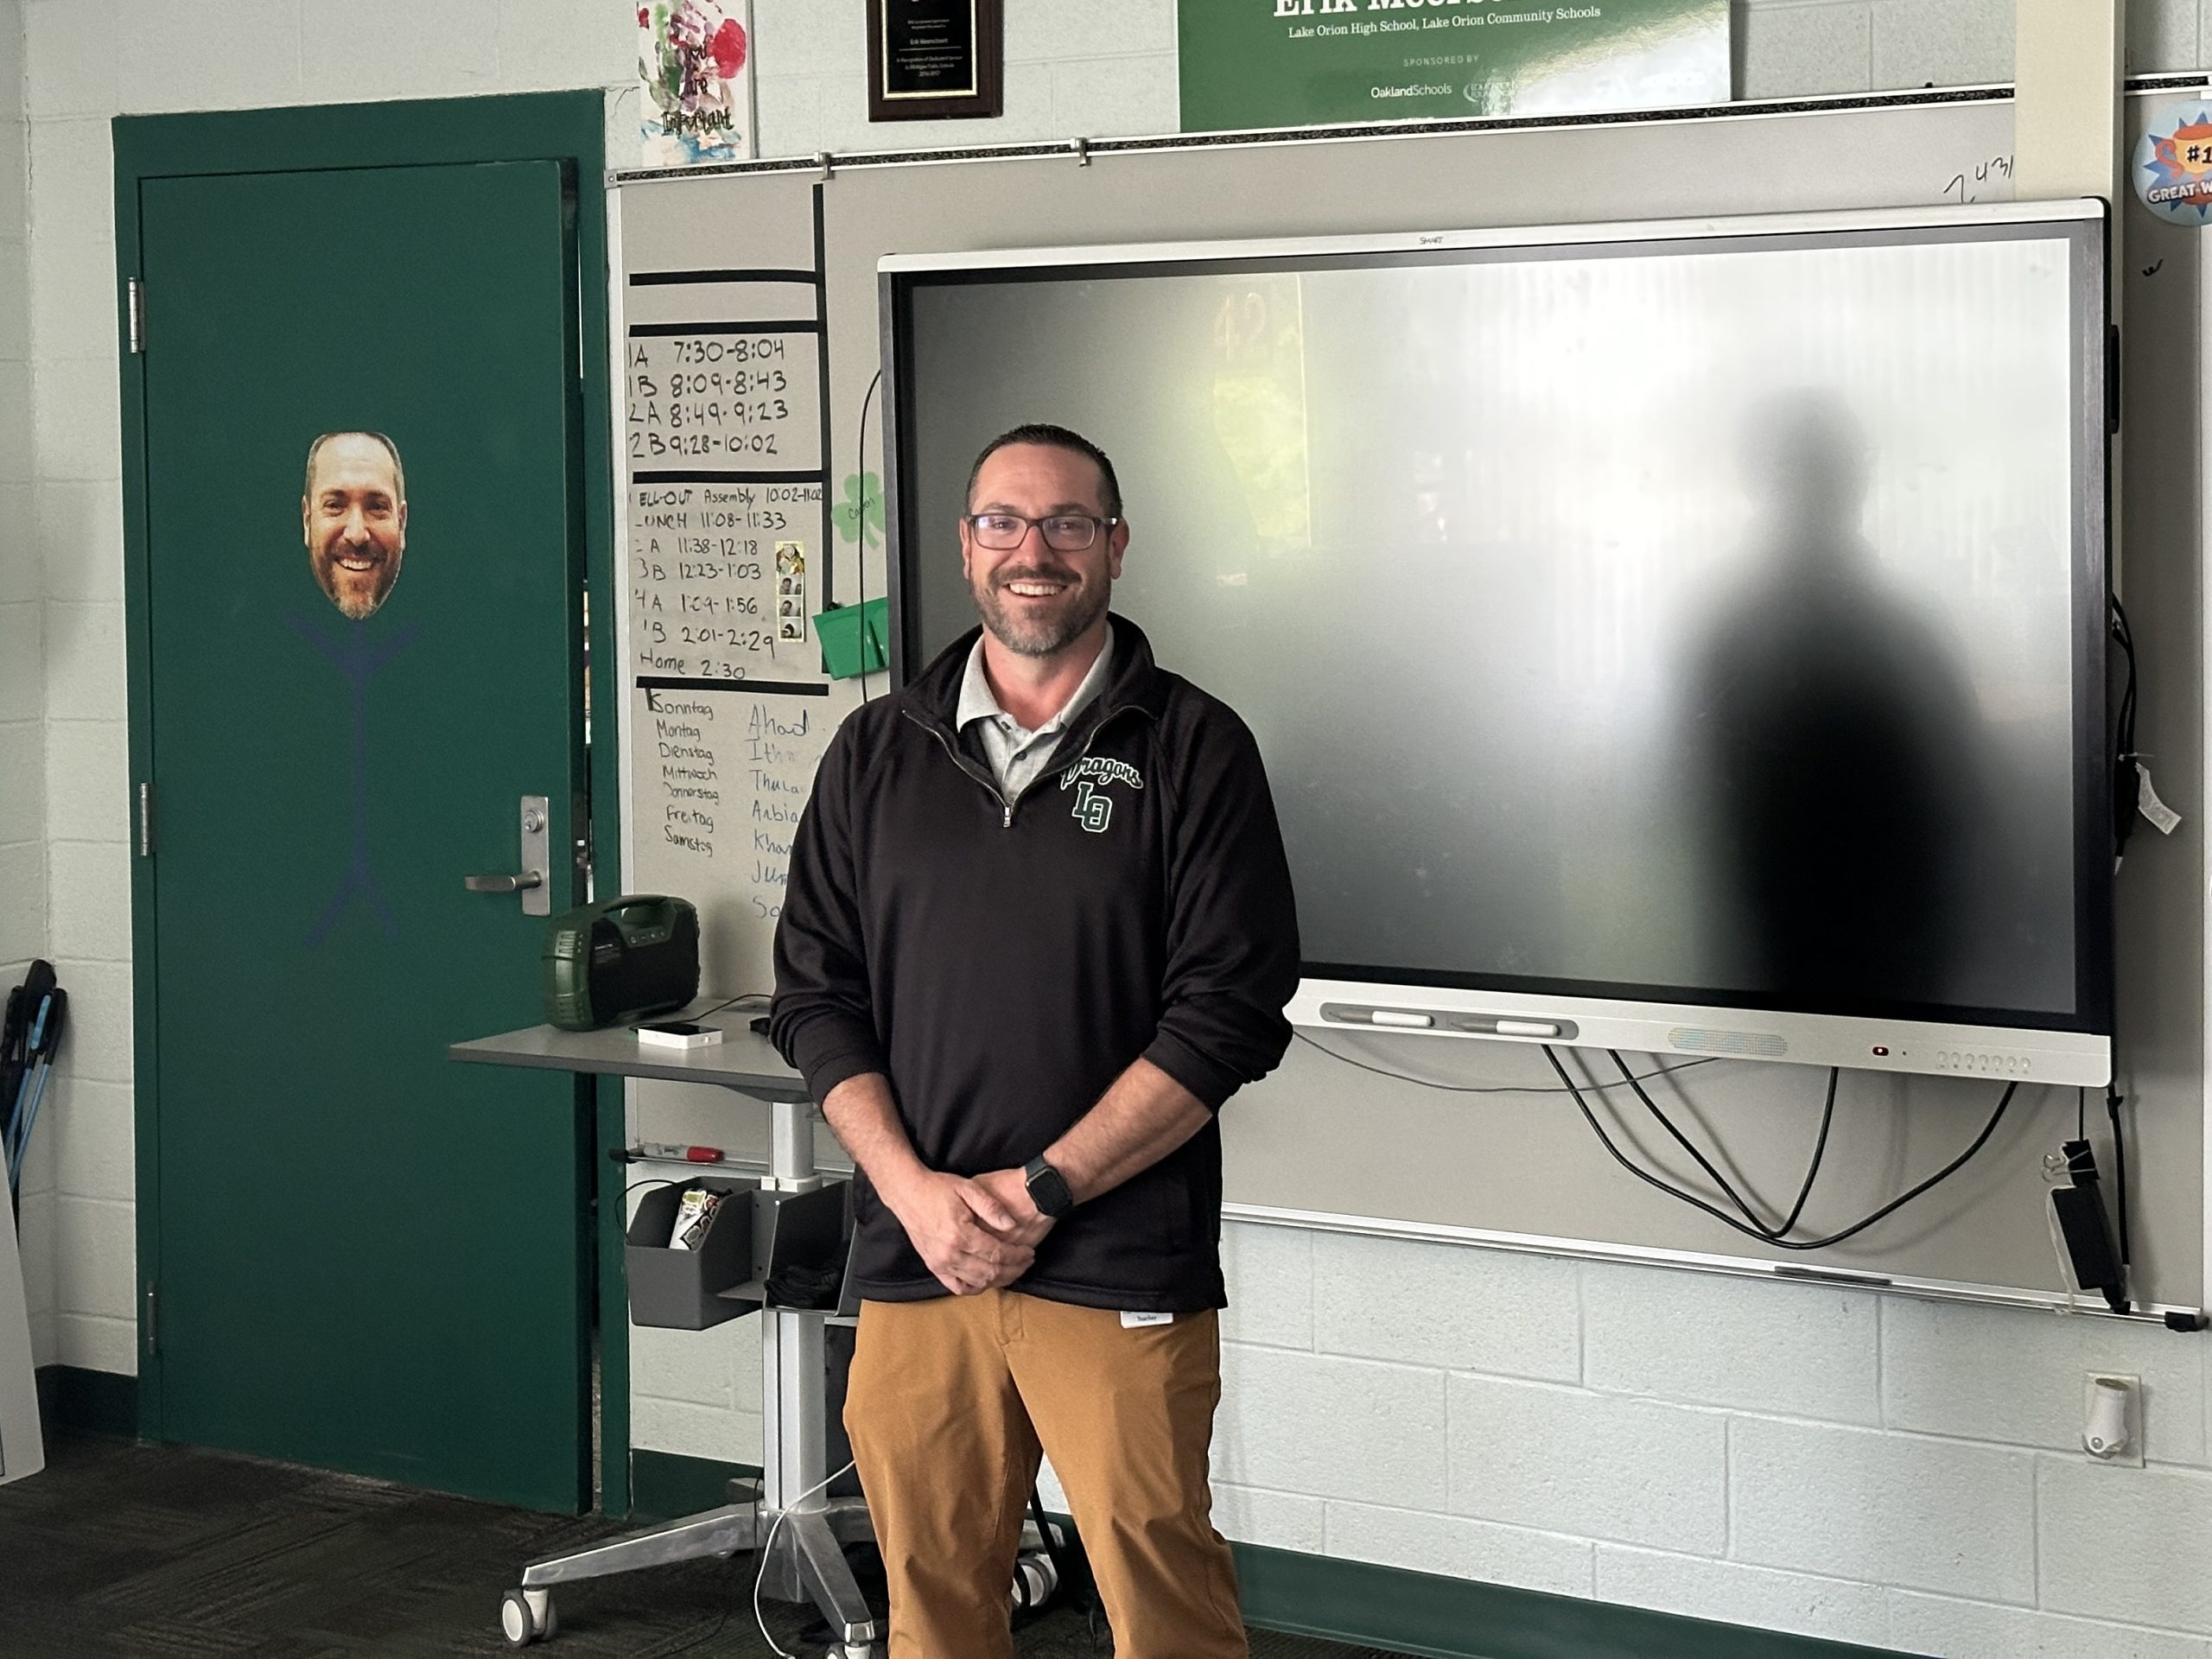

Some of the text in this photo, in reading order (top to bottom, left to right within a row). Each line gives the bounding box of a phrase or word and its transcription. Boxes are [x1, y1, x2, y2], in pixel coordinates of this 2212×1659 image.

[1288, 5, 1601, 38] Lake Orion High School, Lake Orion Community Schools
[1403, 54, 1479, 67] SPONSORED BY
[1370, 83, 1452, 99] OaklandSchools
[2147, 183, 2196, 205] GREAT
[1420, 236, 1444, 245] SMART
[674, 339, 785, 364] 7:30-8:04
[670, 370, 787, 398] 8:09-8:43
[669, 433, 778, 458] 9:28-10:02
[629, 489, 693, 507] ELL-OUT
[703, 488, 756, 510] Assembly
[677, 537, 759, 557] 11:38-12:18
[639, 648, 746, 680] Home 2:30
[656, 718, 702, 743] Montag
[658, 741, 715, 766] Dienstag
[1060, 756, 1143, 791] Dragons
[666, 804, 715, 834] Freitag
